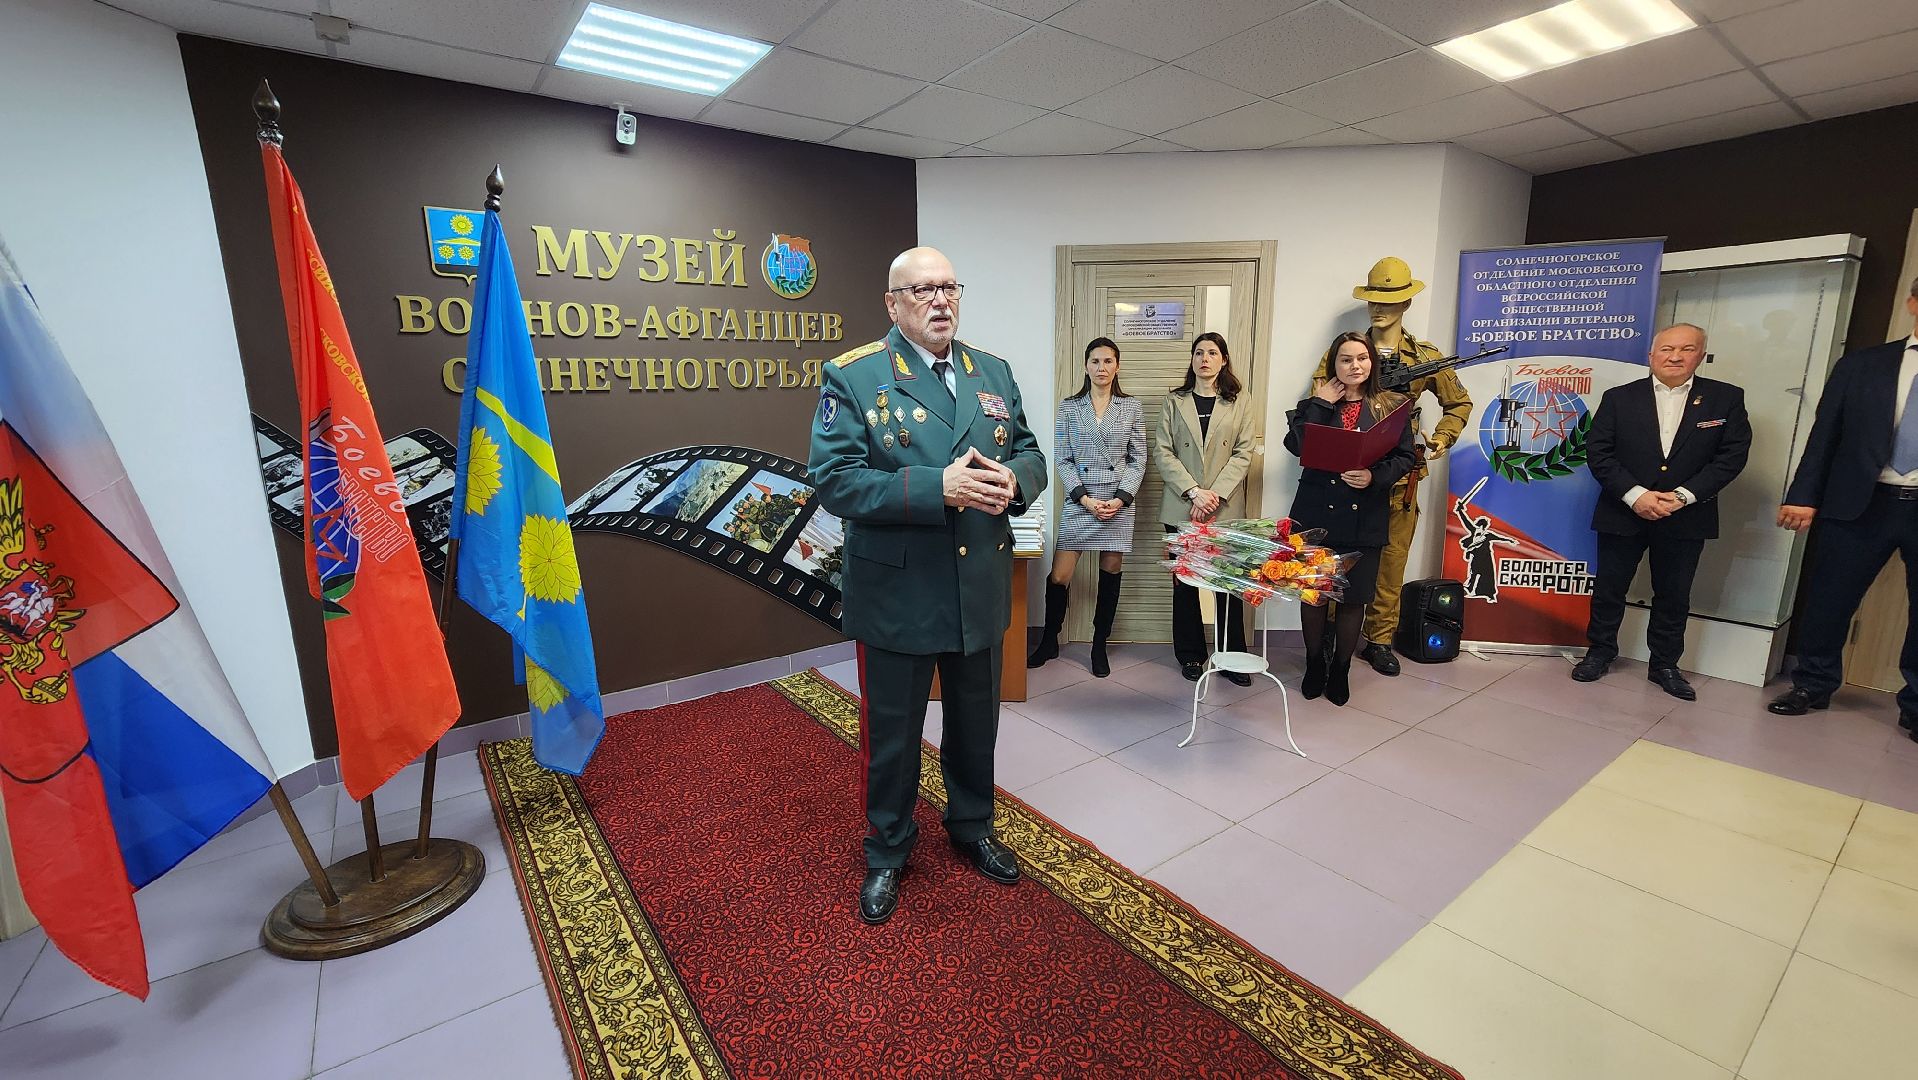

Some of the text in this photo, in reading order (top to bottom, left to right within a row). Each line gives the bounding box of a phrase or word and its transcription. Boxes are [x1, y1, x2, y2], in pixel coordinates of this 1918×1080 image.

[531, 225, 748, 288] МУЗЕЙ
[1496, 252, 1621, 267] СОЛНЕЧНОГОРСКОЕ
[1473, 263, 1643, 280] ОТДЕЛЕНИЕ МОСКОВСКОГО
[1476, 276, 1637, 292] ОБЛАСТНОГО ОТДЕЛЕНИЯ
[1501, 289, 1608, 303] ВСЕРОССИЙСКОЙ
[1501, 302, 1605, 315] ОБЩЕСТВЕННОЙ
[396, 295, 844, 348] ВОНОВ-АФГАНЦЕВ
[1472, 314, 1636, 328] ОРГАНИЗАЦИИ ВЕТЕРАНОВ
[1464, 327, 1642, 343] «БОЕВОЕ БРАТСТВО»
[442, 357, 823, 393] СНЕЧНОГОРЬЯ
[1515, 364, 1593, 376] Боевое
[1538, 377, 1591, 395] БРАТСТВО
[332, 416, 411, 529] Боево
[1501, 560, 1586, 575] ВОЛОНТЕР
